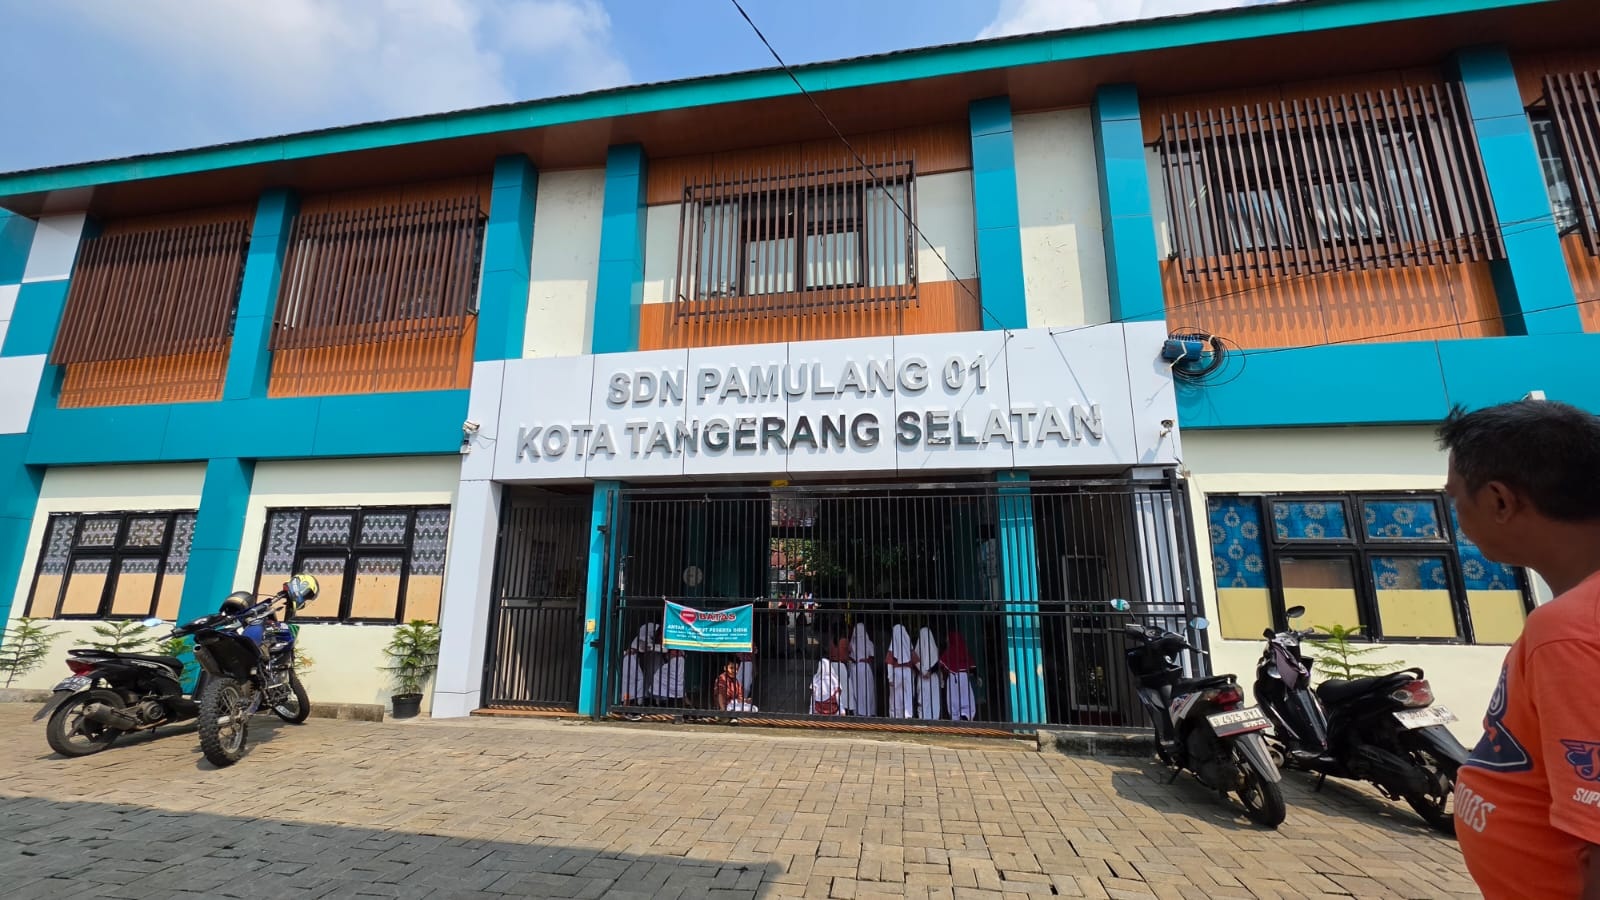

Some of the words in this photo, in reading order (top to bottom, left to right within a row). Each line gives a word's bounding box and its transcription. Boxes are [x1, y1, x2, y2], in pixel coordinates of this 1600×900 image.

[608, 370, 685, 405] SDN
[697, 357, 928, 400] PAMULANG
[945, 354, 987, 390] 01
[518, 423, 616, 458] KOTA
[626, 412, 880, 455] TANGERANG
[897, 403, 1103, 446] SELATAN
[699, 613, 737, 622] BATAS
